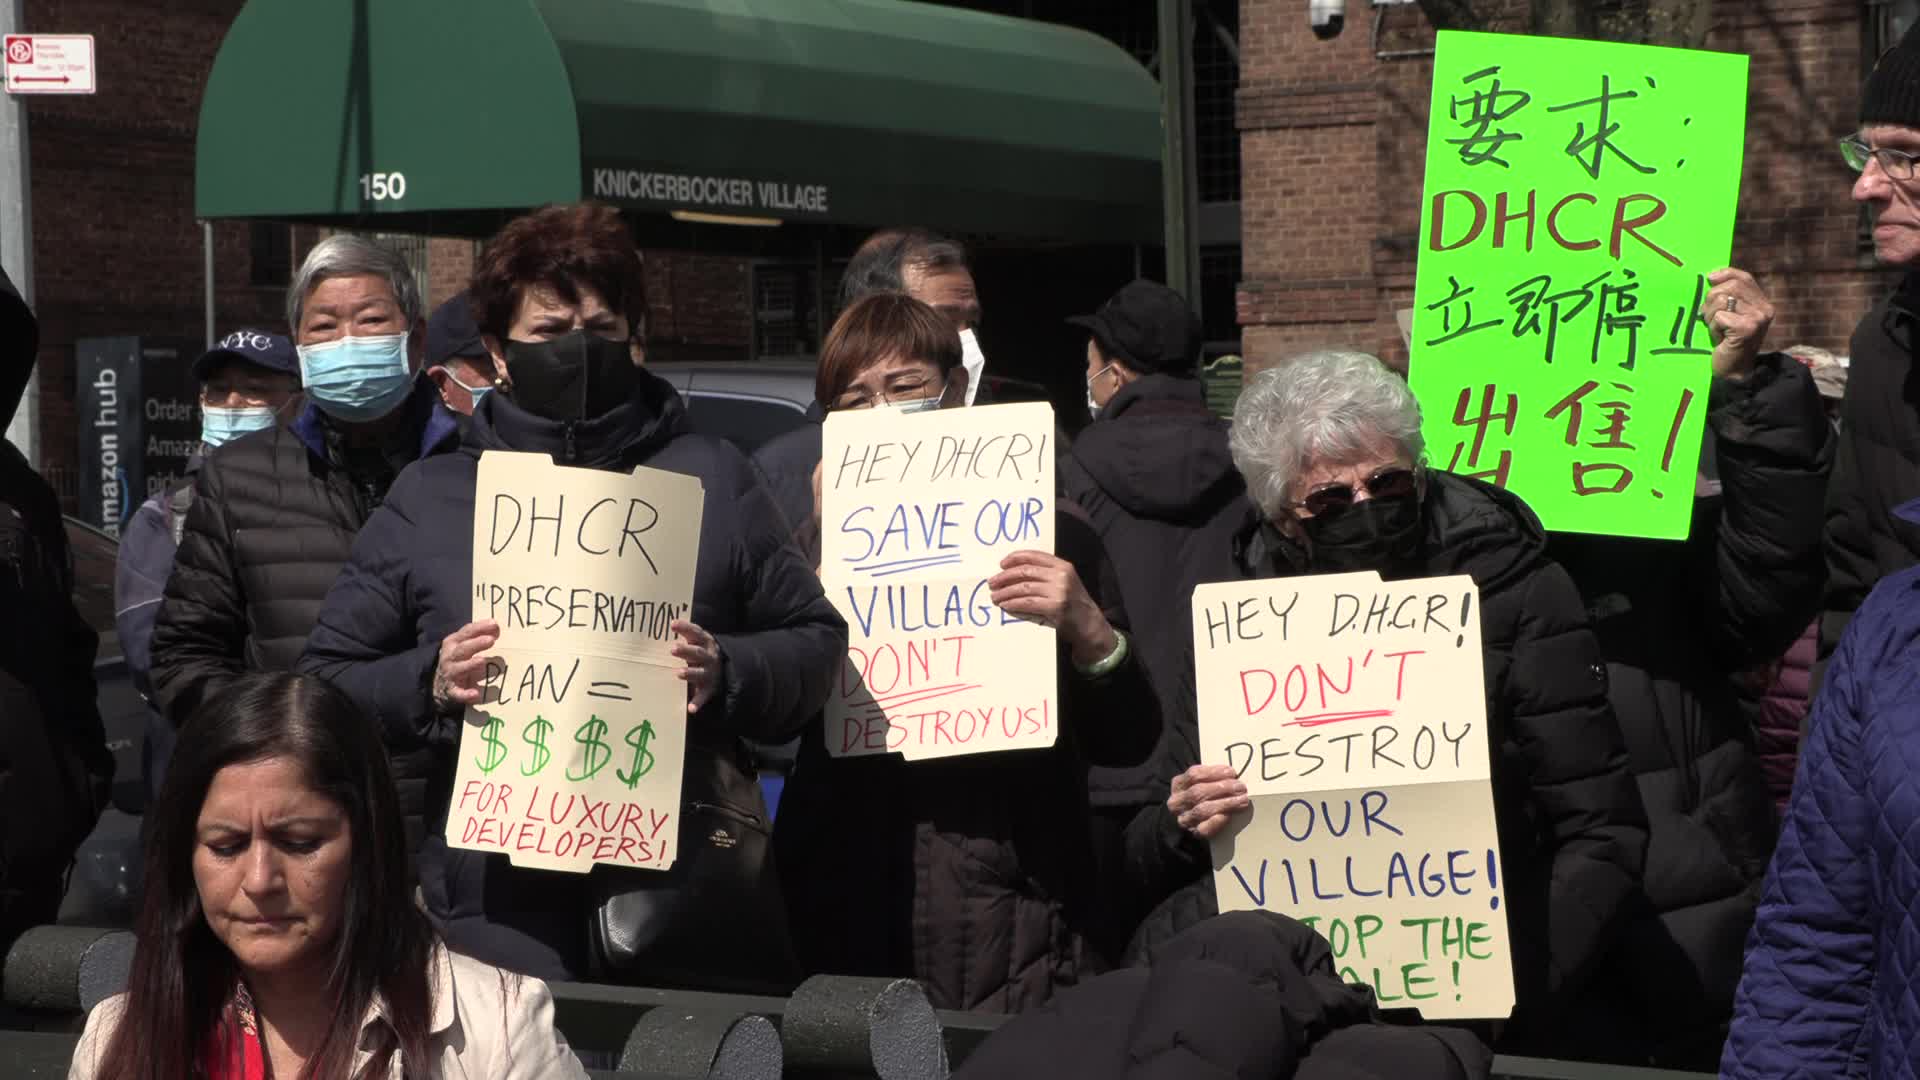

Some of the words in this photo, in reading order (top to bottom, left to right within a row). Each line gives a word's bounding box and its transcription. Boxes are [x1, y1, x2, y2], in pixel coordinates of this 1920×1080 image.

[360, 172, 406, 200] 150
[593, 168, 753, 206] KNICKERBOCKER
[758, 181, 828, 212] VILLAGE
[1429, 189, 1683, 267] DHCR
[1424, 269, 1711, 370] 立即停止
[94, 368, 117, 427] hub
[145, 397, 192, 420] Order
[834, 441, 922, 491] HEY
[932, 433, 1048, 486] DHCR!
[490, 494, 660, 575] DHCR
[840, 501, 964, 562] SAVE
[973, 497, 1044, 546] OUR
[476, 582, 689, 642] "PRESERVATION"
[1205, 592, 1299, 650] HEY
[483, 657, 580, 706] PLAN
[841, 635, 976, 699] DON'T
[1239, 649, 1427, 716] DON'T
[841, 707, 994, 753] DESTROY
[1002, 698, 1049, 740] US!
[1224, 722, 1472, 782] DESTROY
[459, 780, 513, 815] FOR
[525, 785, 669, 840] LUXURY
[1279, 790, 1404, 842] OUR
[461, 817, 669, 868] DEVELOPERS!
[1230, 849, 1500, 911] VILLAGE!
[1400, 916, 1493, 961] THE
